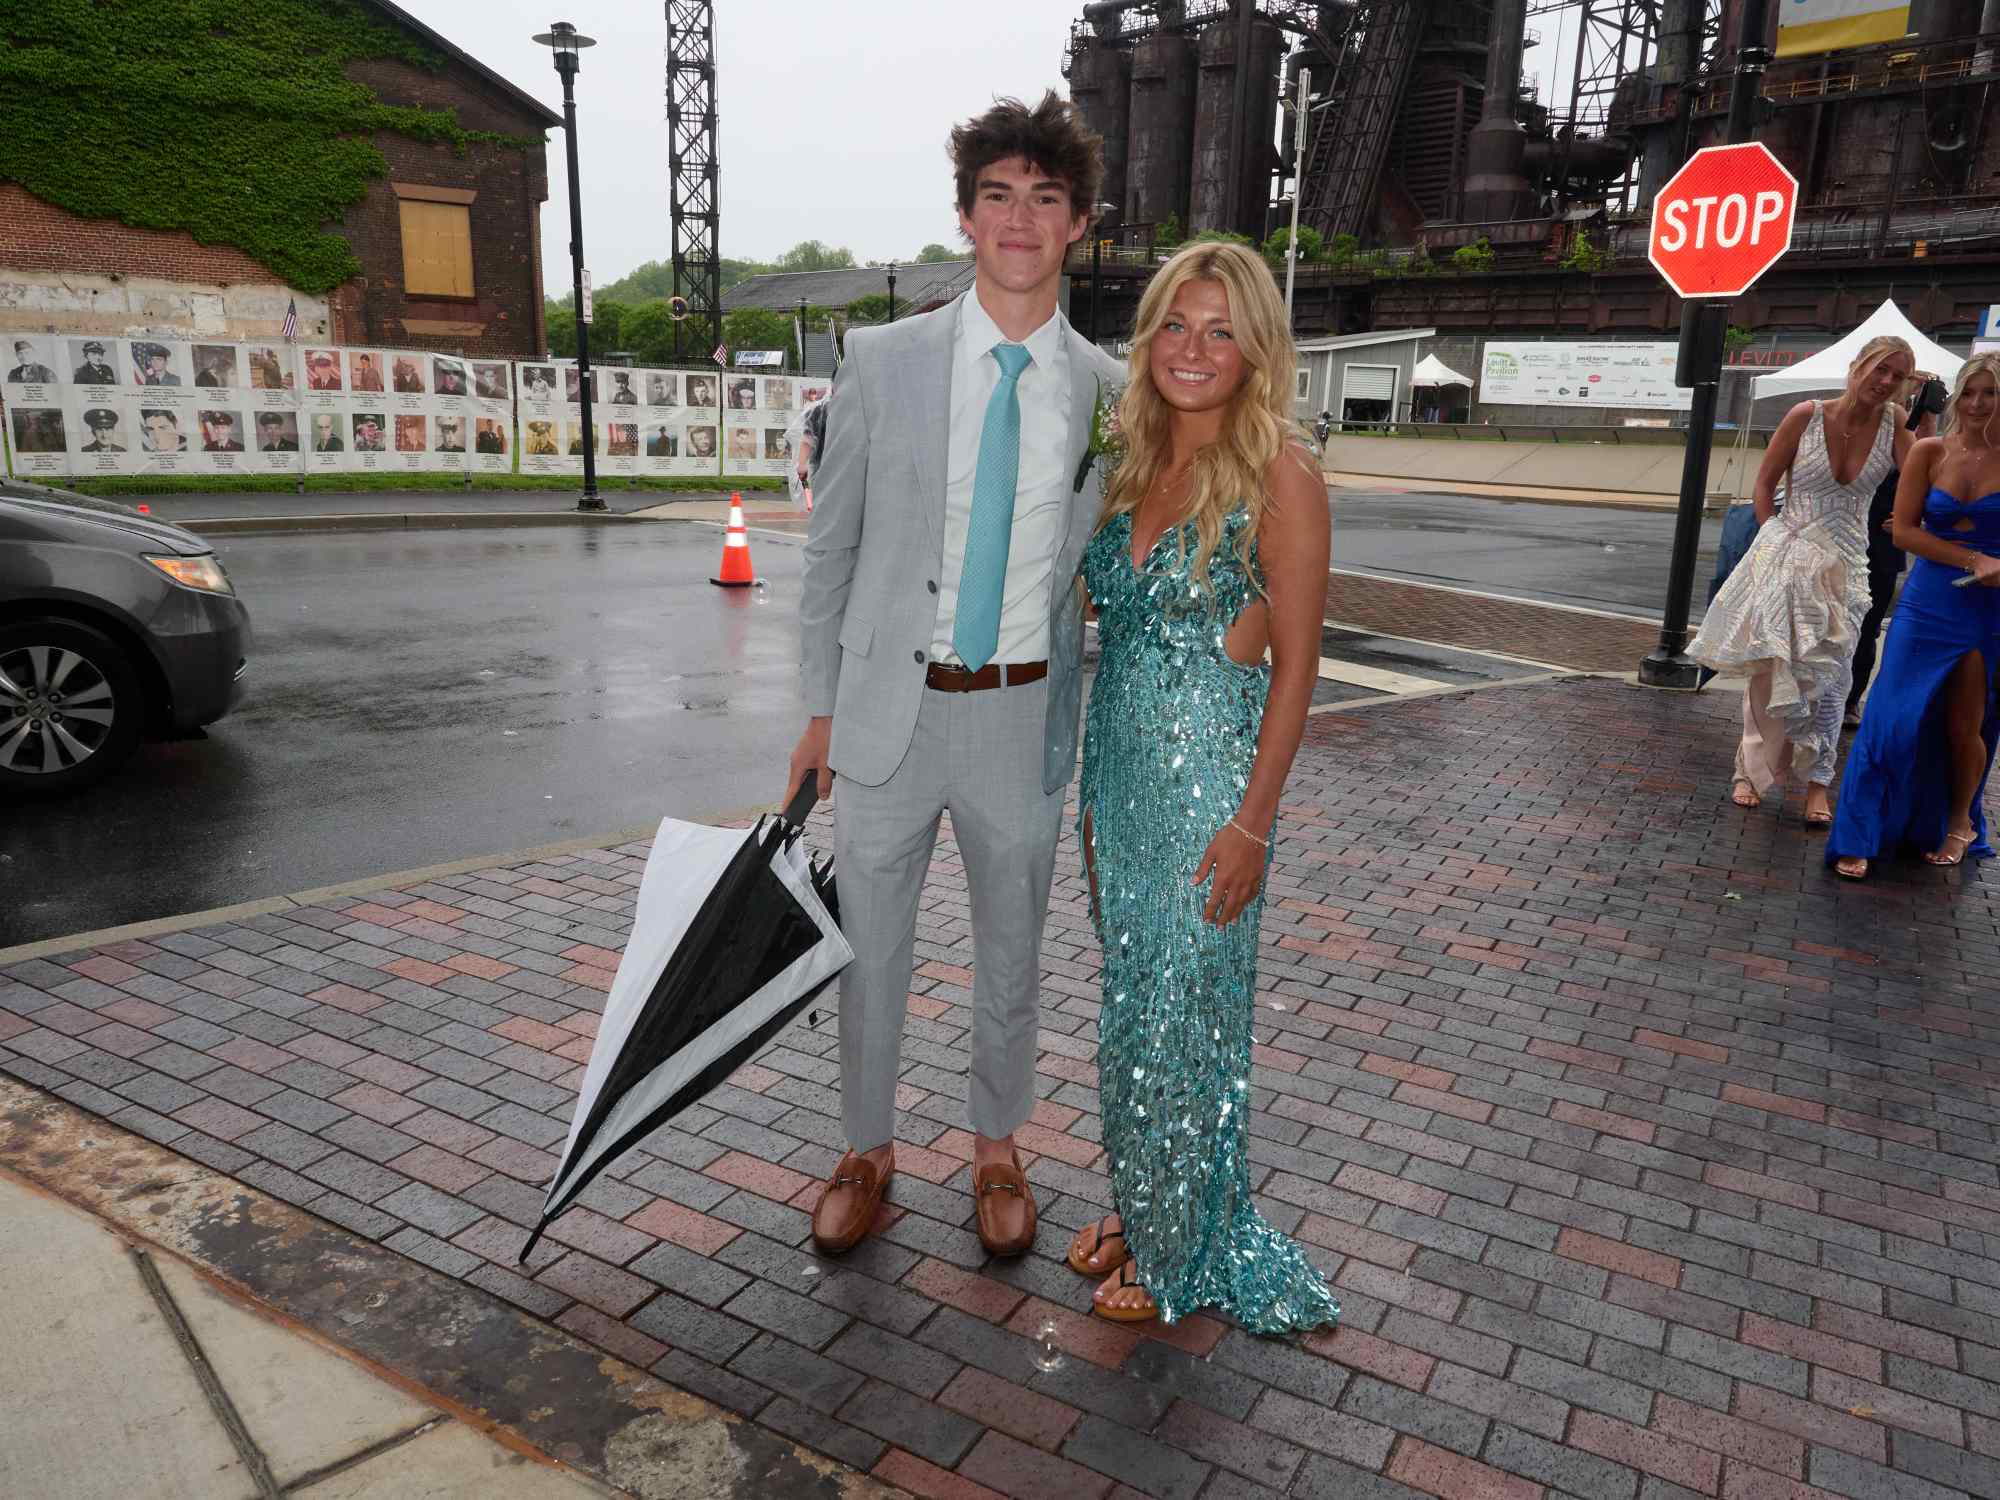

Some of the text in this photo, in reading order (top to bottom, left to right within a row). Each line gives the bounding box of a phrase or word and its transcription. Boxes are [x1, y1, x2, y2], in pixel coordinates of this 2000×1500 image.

[1660, 191, 1784, 252] STOP
[1117, 343, 1136, 354] Ma
[1728, 351, 1796, 367] LEVITT
